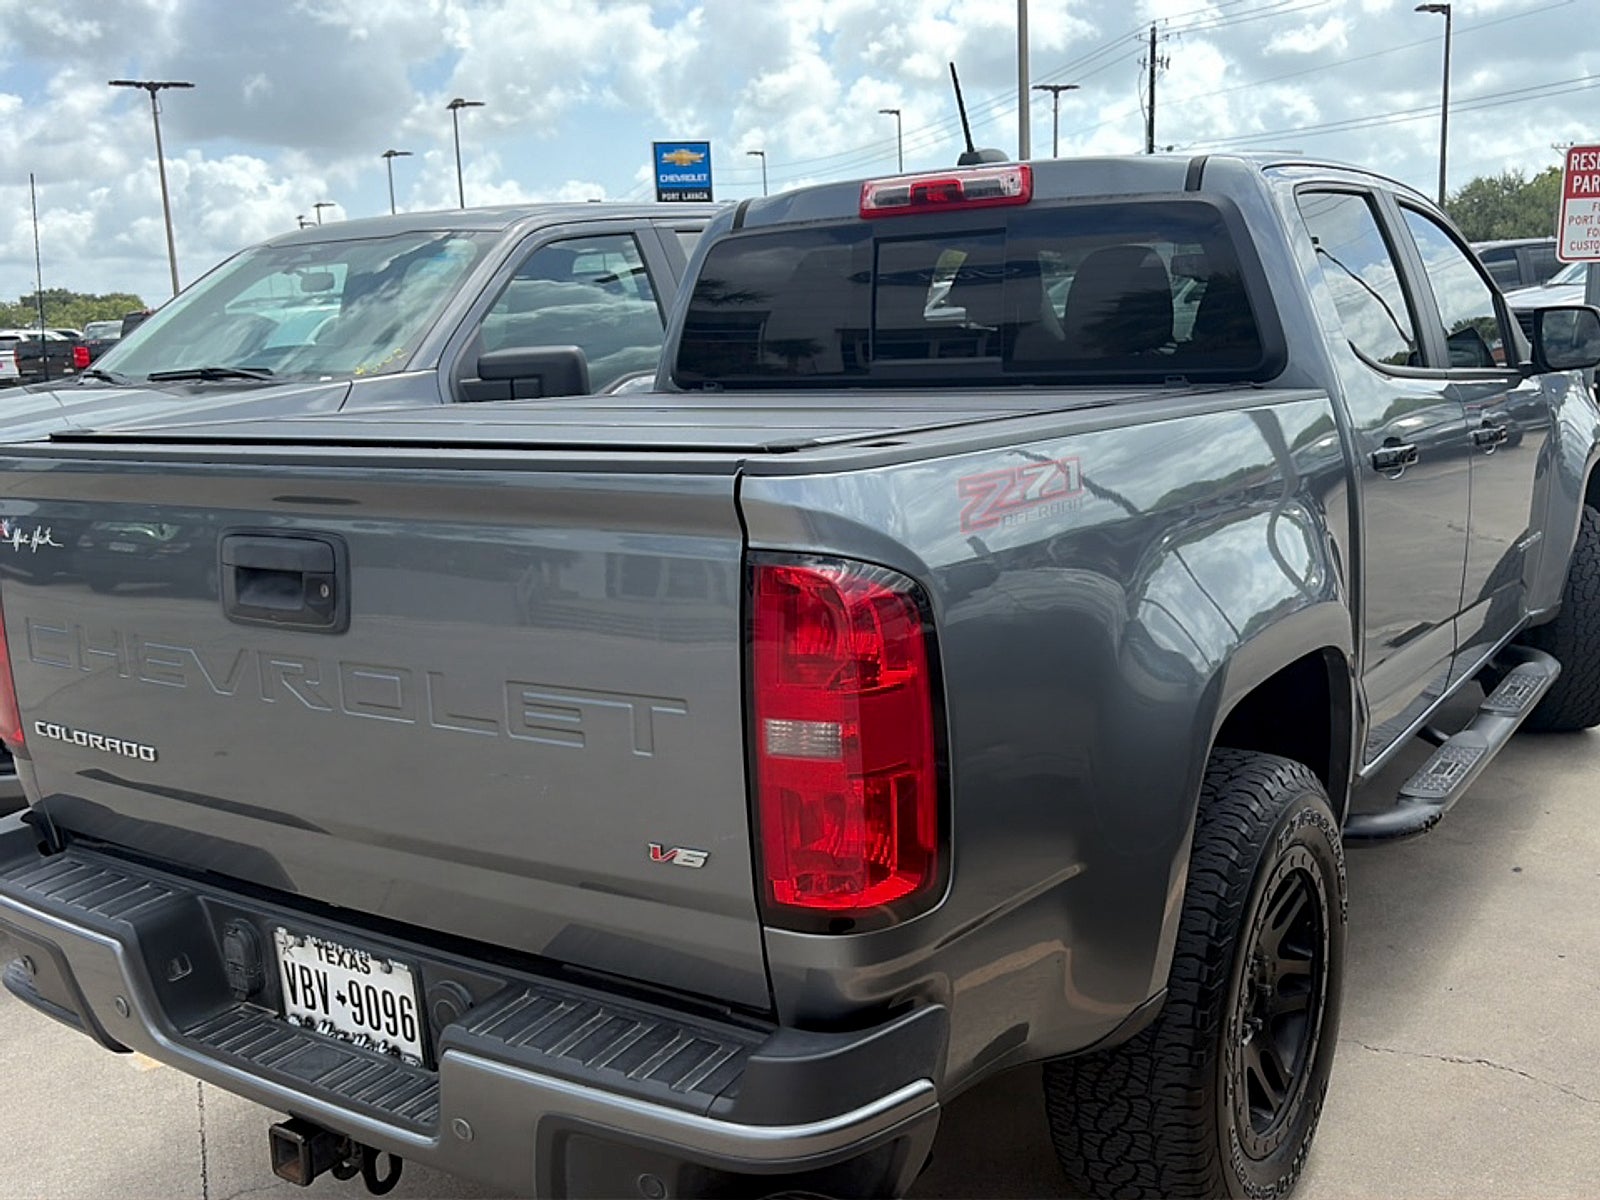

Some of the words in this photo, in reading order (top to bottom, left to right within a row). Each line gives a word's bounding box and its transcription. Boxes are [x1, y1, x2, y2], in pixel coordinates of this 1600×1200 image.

[660, 173, 706, 182] CHEVROLET
[662, 191, 680, 200] PORT
[1568, 215, 1594, 226] PORT
[958, 456, 1082, 534] Z71
[25, 616, 688, 757] CHEVROLET
[35, 720, 157, 762] COLORADO
[648, 842, 710, 869] V6
[314, 943, 371, 974] TEXAS
[284, 960, 330, 1015] VBV
[349, 980, 416, 1043] 9096
